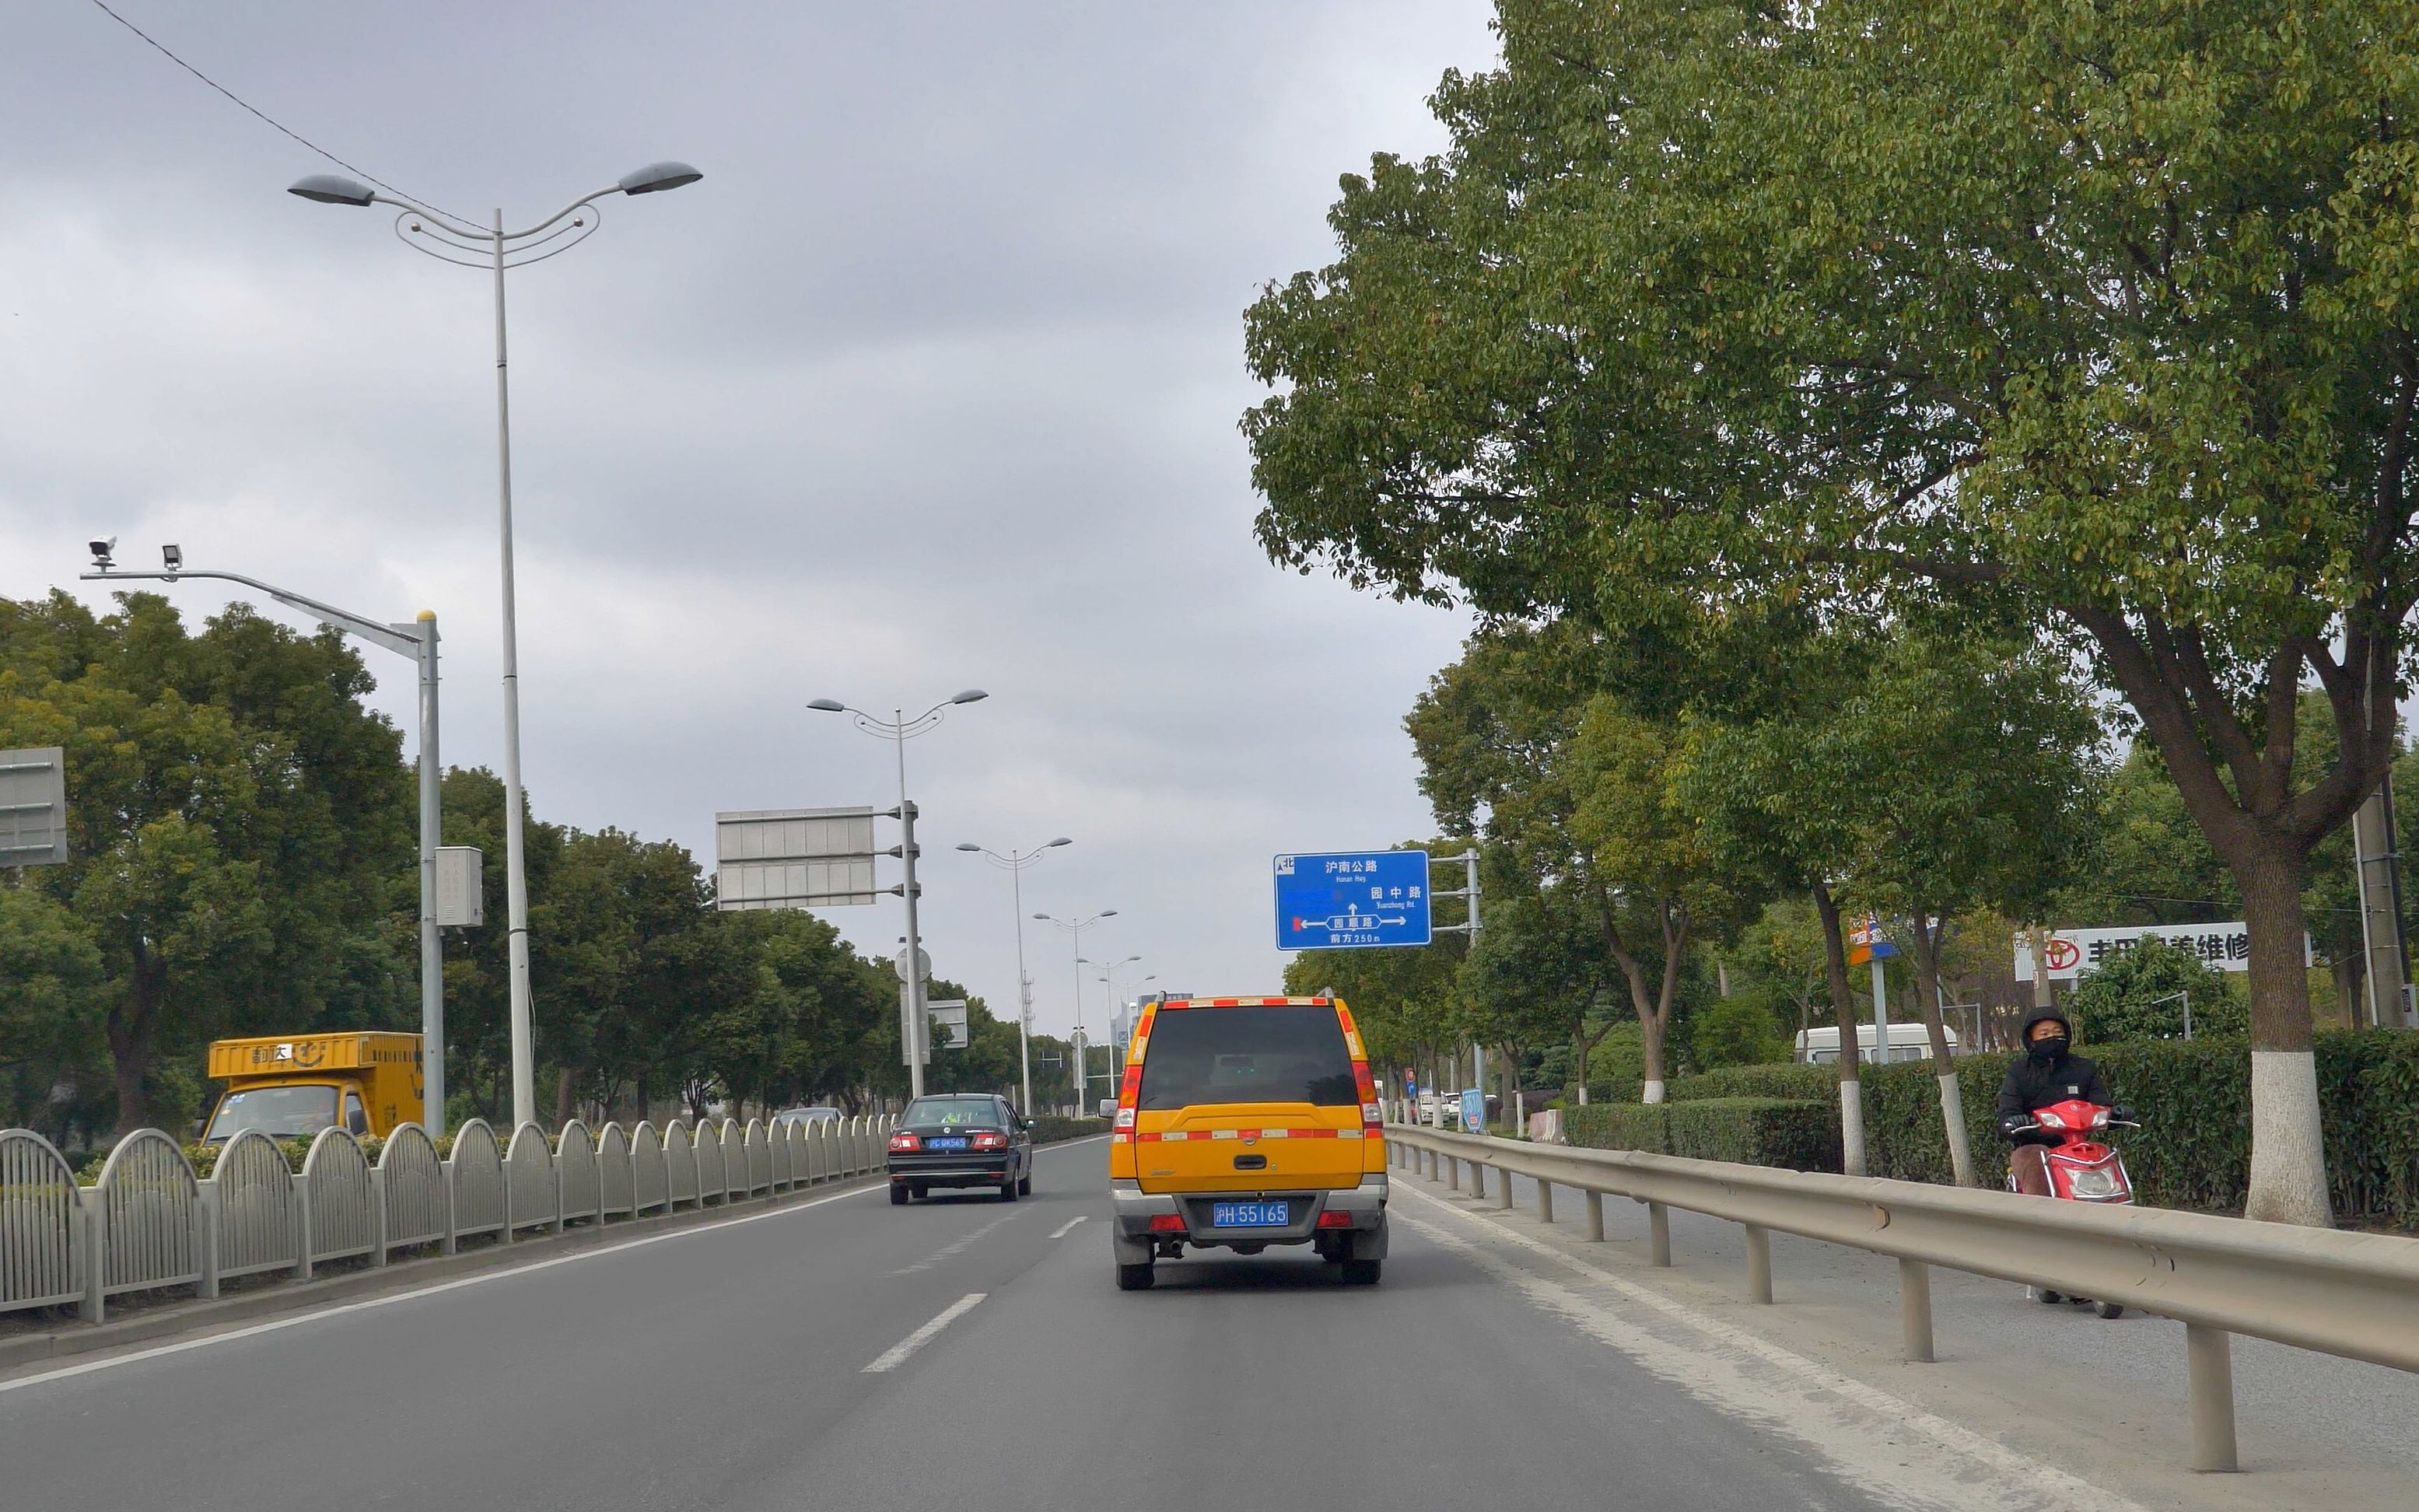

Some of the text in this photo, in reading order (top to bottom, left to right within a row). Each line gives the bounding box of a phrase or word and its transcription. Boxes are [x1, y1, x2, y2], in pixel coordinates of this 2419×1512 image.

[1283, 857, 1294, 868] 北
[1325, 859, 1378, 873] 沪南公路
[1371, 886, 1422, 899] 园中路
